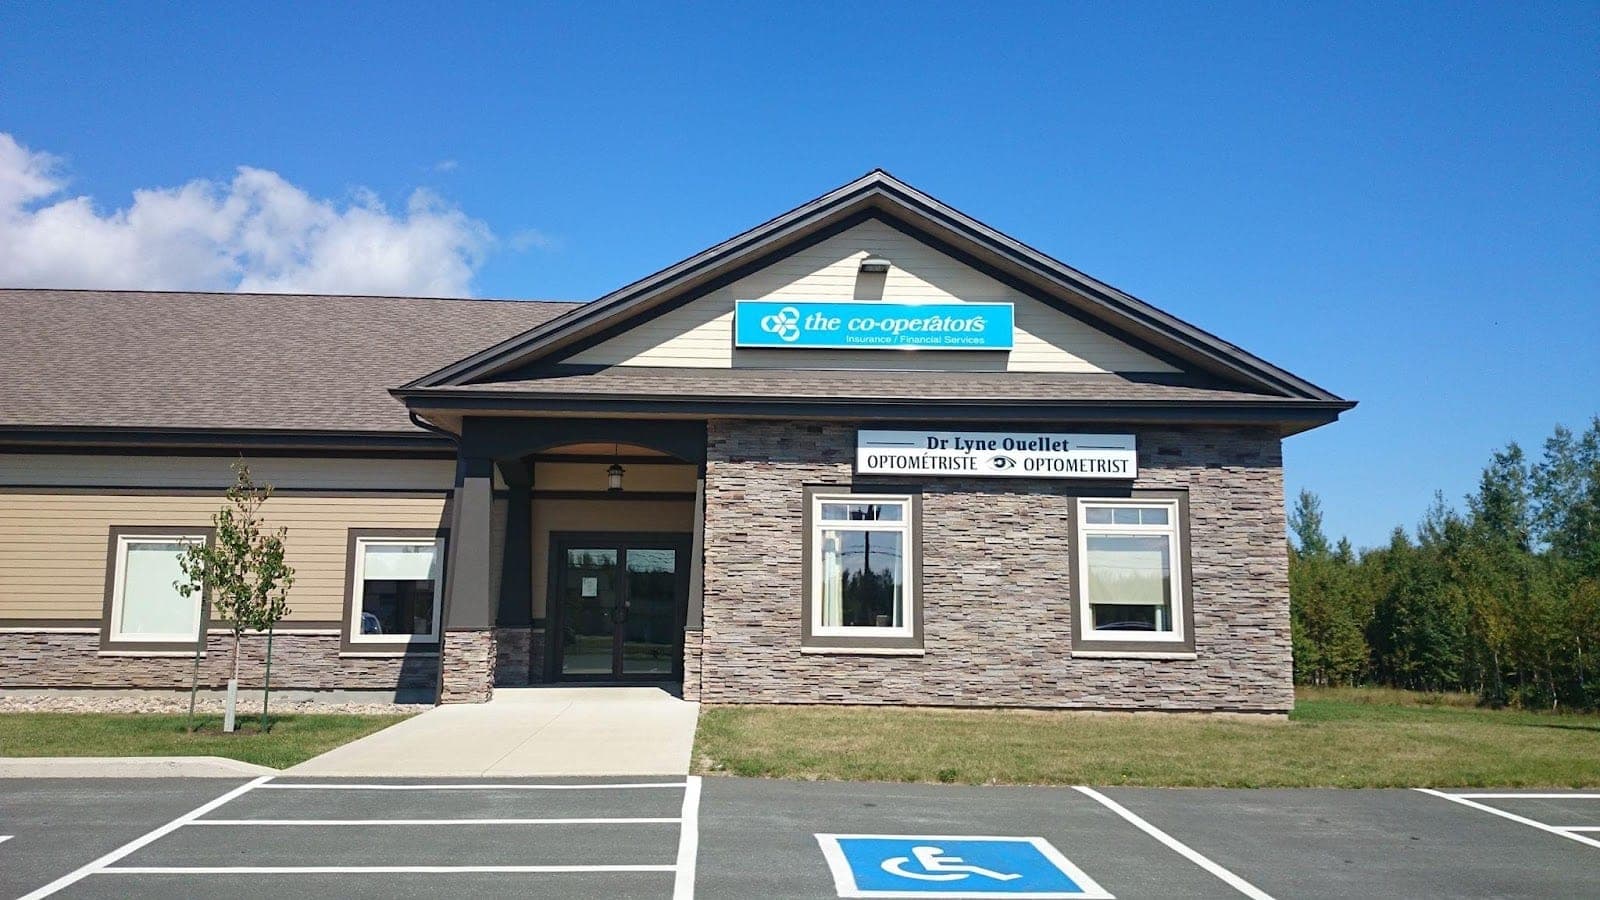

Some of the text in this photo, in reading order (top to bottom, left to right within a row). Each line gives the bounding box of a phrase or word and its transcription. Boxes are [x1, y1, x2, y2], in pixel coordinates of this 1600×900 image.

[804, 311, 985, 335] the co-operators
[846, 335, 891, 343] Insurance
[900, 335, 941, 344] Financial
[944, 335, 985, 345] Services
[926, 436, 1069, 454] Dr Lyne Ouellet
[867, 452, 978, 471] OPTOMÉTRISTE
[1023, 458, 1129, 473] OPTOMETRIST
